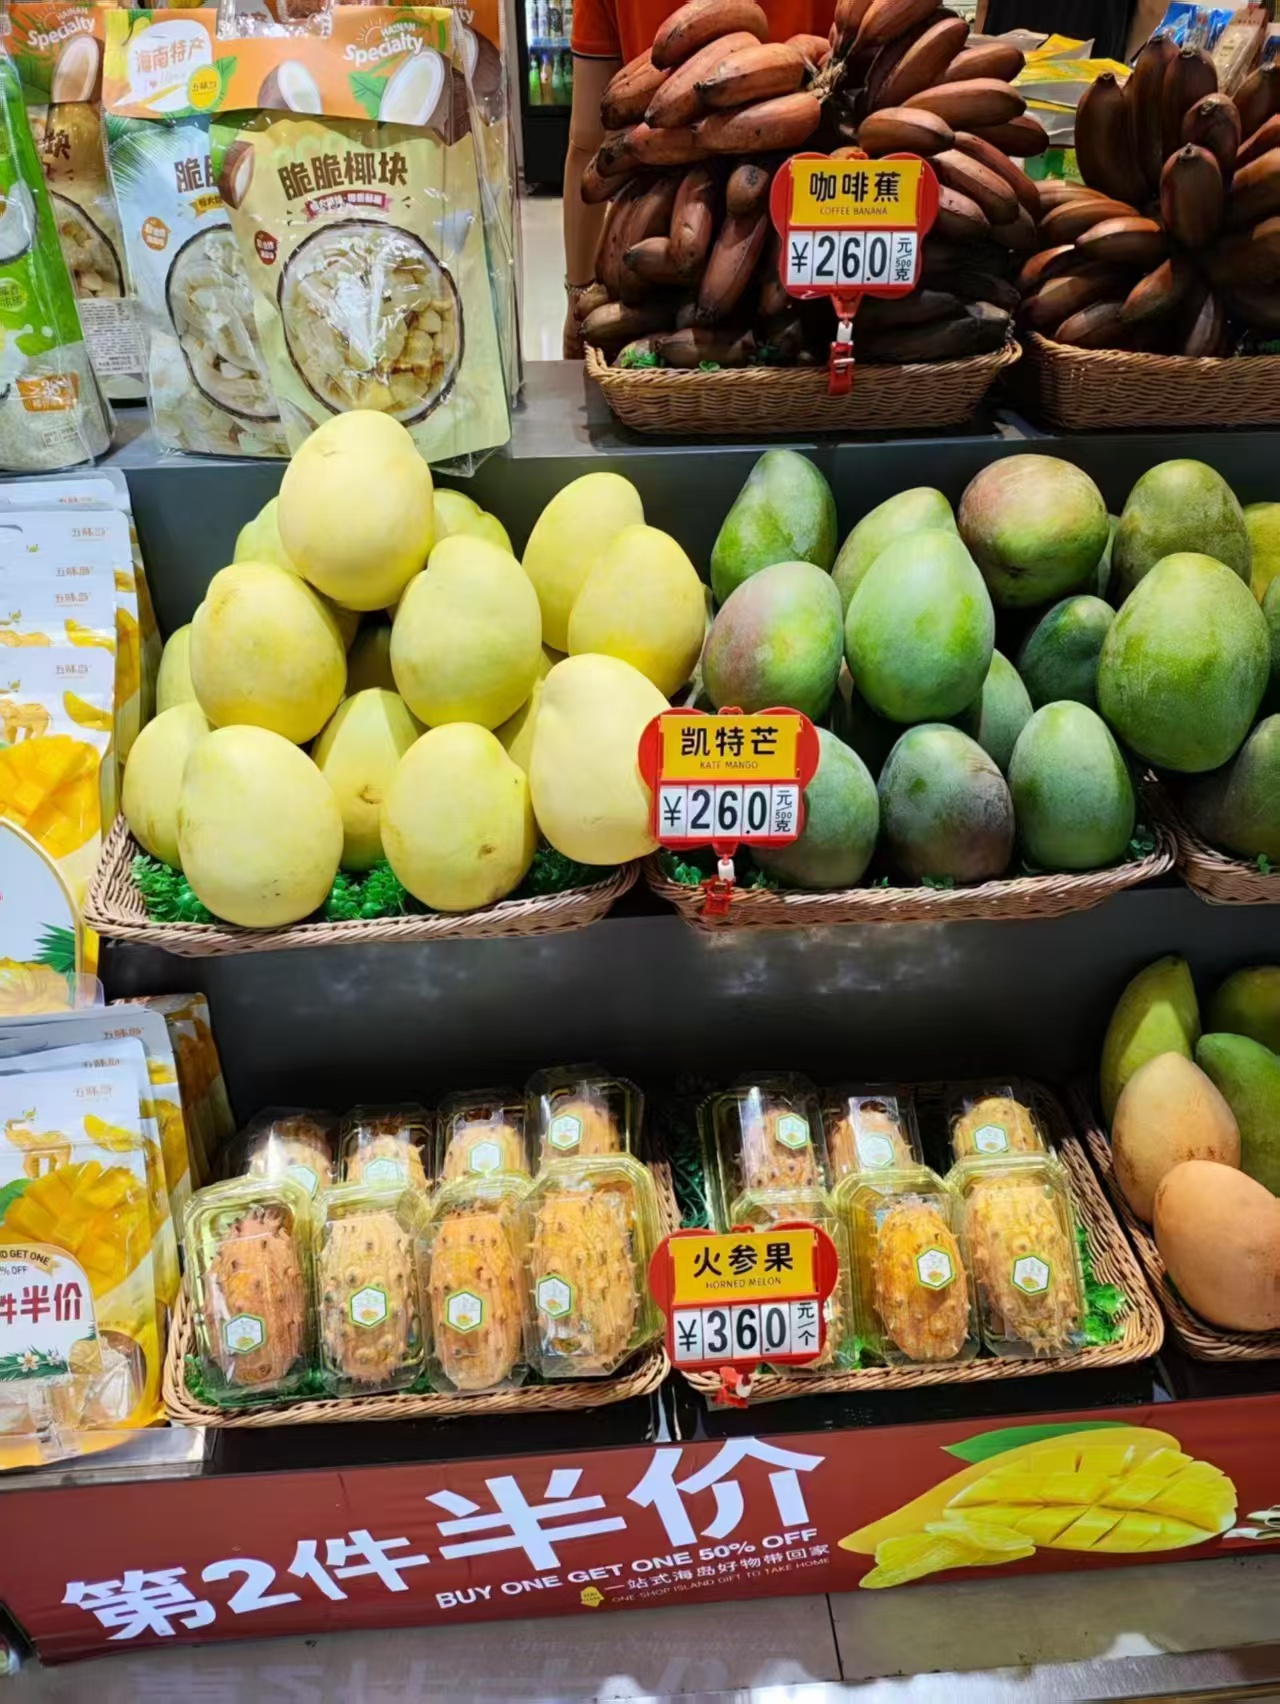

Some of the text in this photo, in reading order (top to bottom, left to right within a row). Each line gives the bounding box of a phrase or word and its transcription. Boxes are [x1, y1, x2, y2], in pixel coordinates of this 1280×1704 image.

[27, 16, 95, 51] Specialty
[343, 32, 423, 67] Specialty
[277, 150, 409, 201] 脆脆椰块
[809, 171, 901, 203] 咖啡蕉
[819, 206, 888, 216] COFFEE BANANA
[680, 726, 778, 757] 凯特芒
[725, 760, 758, 769] MANGO
[9, 1249, 29, 1259] GET
[30, 1251, 50, 1266] ONE
[11, 1266, 28, 1275] OFF
[693, 1242, 794, 1279] 火参果
[705, 1276, 782, 1289] HORNED MELON
[61, 1436, 826, 1641] 第2件半价
[435, 1528, 818, 1609] BUY ONE GET ONE 50% OFF
[604, 1543, 830, 1591] 一站式海岛好物带回家
[611, 1595, 635, 1603] ONE
[639, 1587, 671, 1600] SHOP
[673, 1579, 715, 1593] ISLAND
[717, 1573, 742, 1586] GIFT
[746, 1570, 761, 1580] TO
[764, 1564, 792, 1576] TAKE
[796, 1557, 830, 1569] HOME
